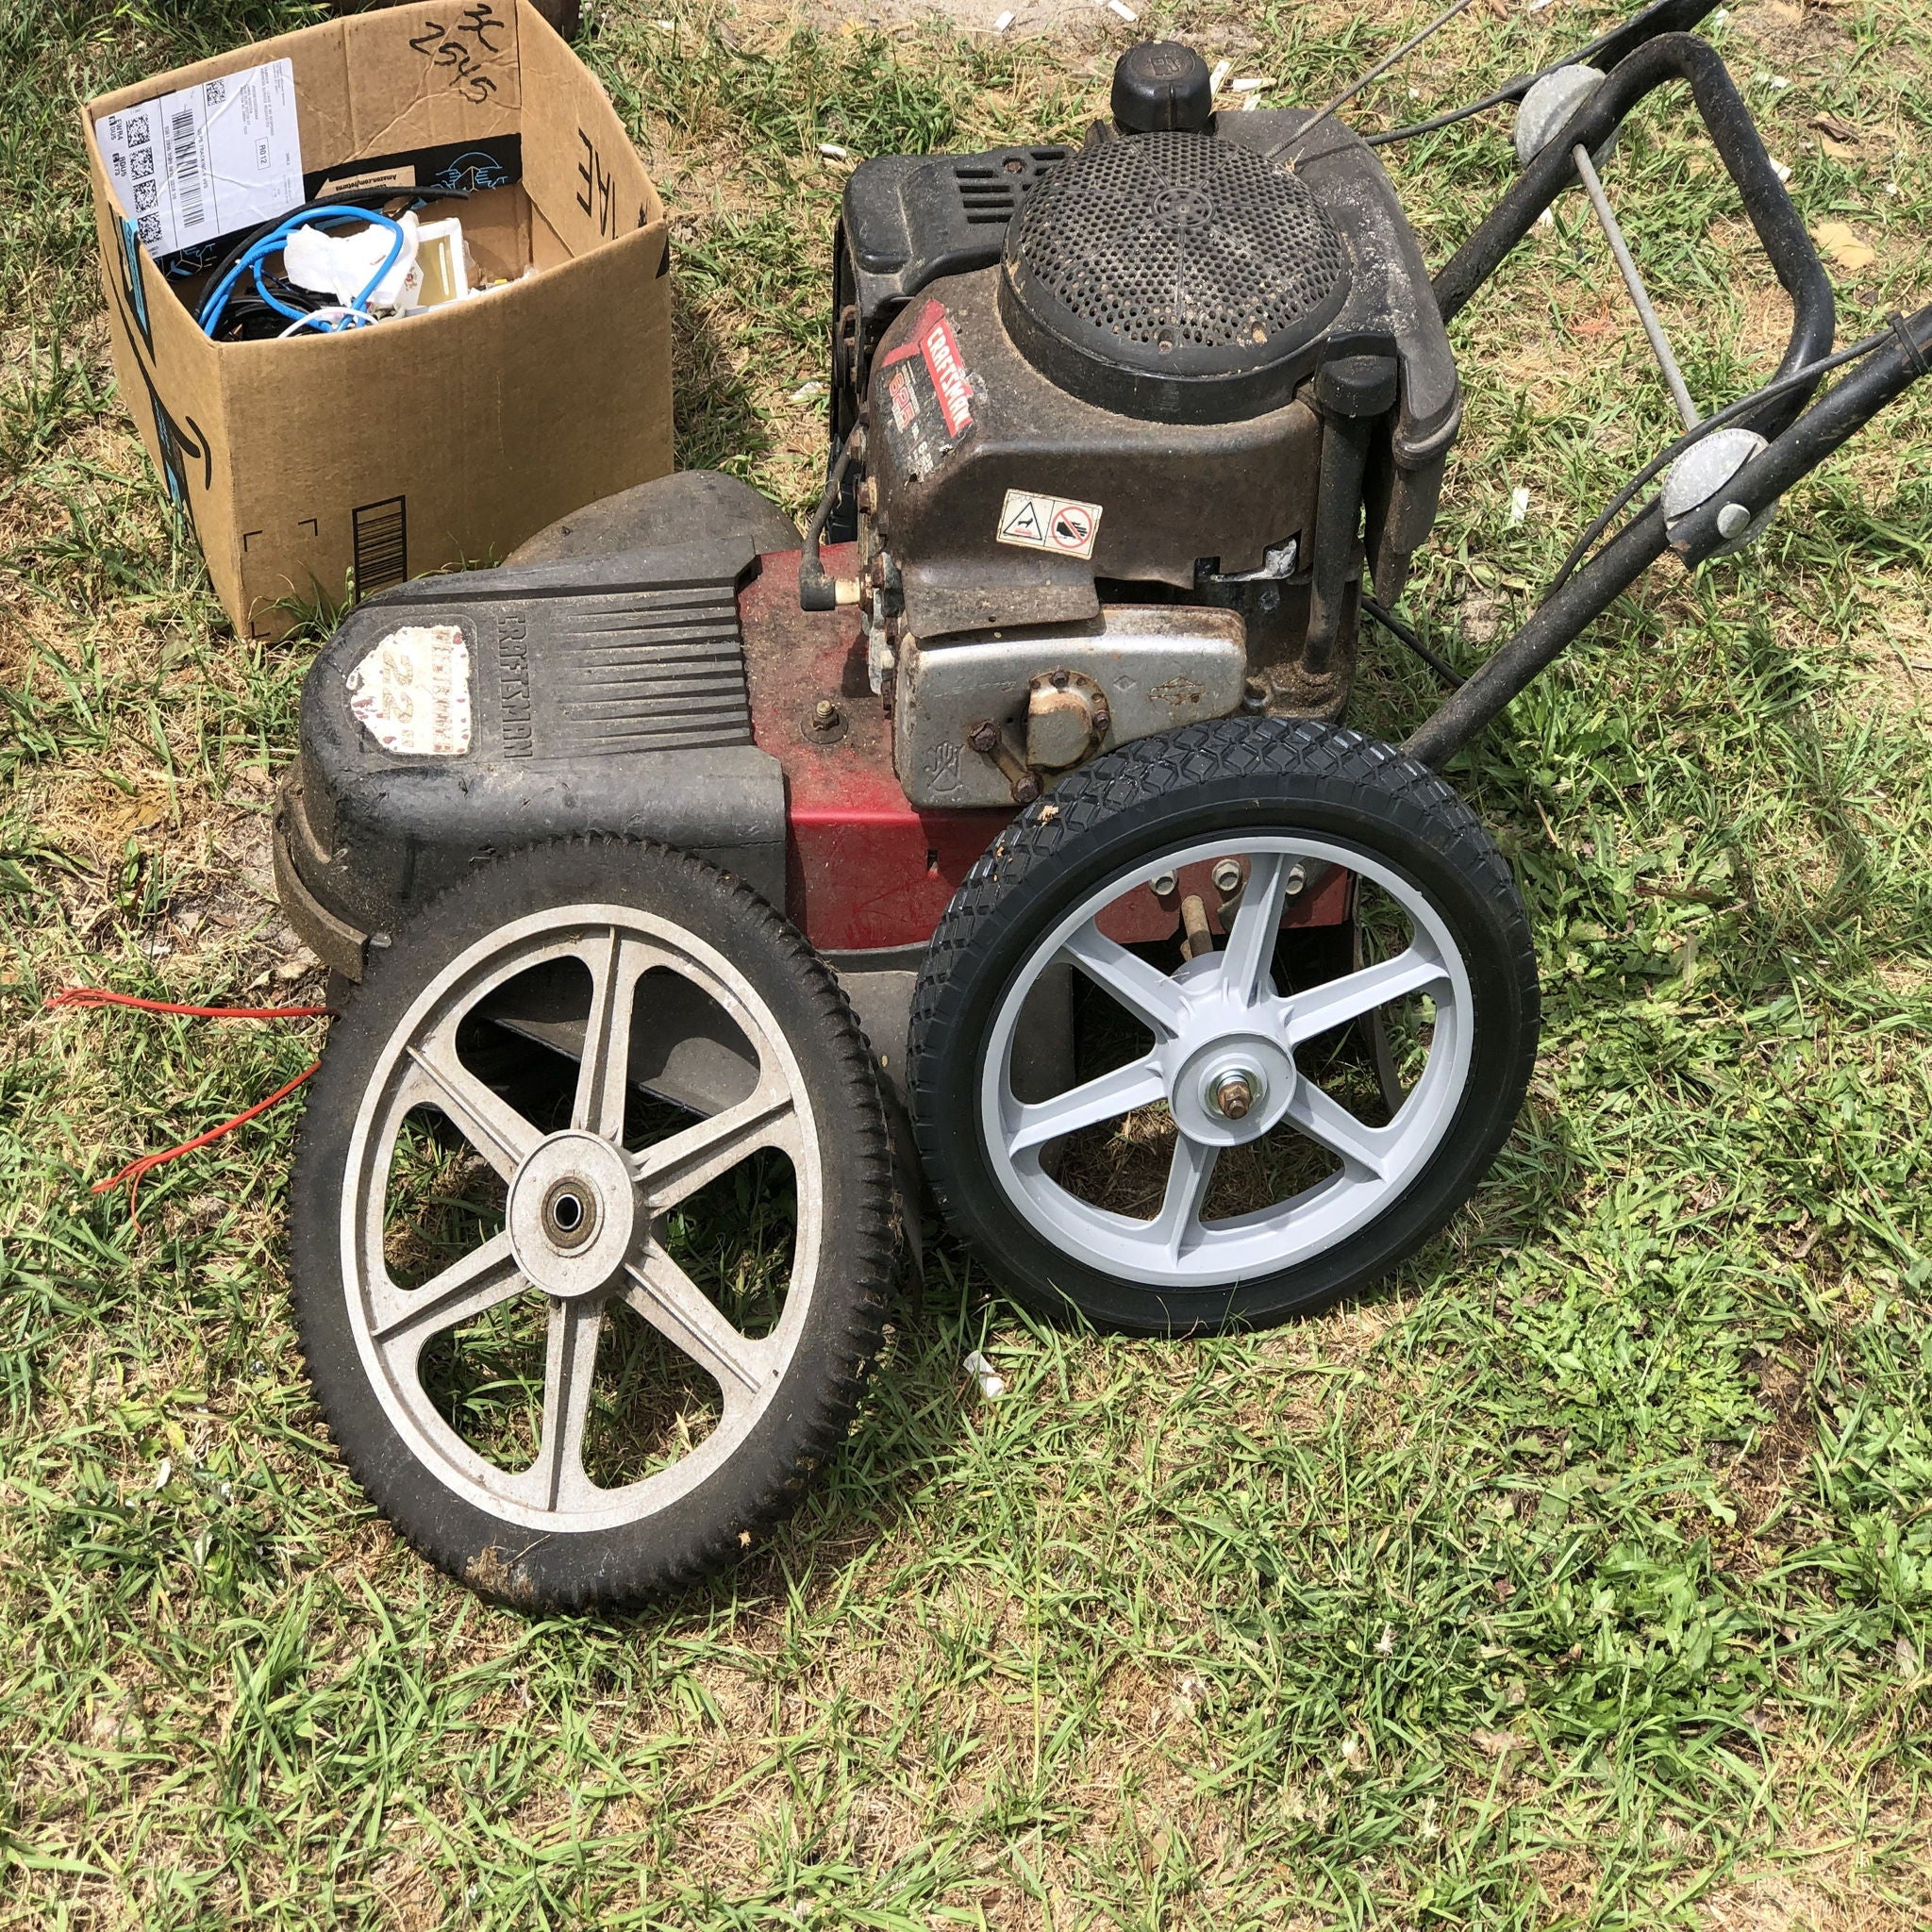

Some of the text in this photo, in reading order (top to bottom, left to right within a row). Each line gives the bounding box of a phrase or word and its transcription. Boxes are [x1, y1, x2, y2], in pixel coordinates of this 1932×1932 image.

[408, 21, 497, 104] 2545
[335, 175, 397, 192] Amazon.com/returns
[889, 371, 916, 428] 625
[926, 326, 972, 427] CRAFTSMAN
[497, 614, 533, 758] CRAFTSMAN
